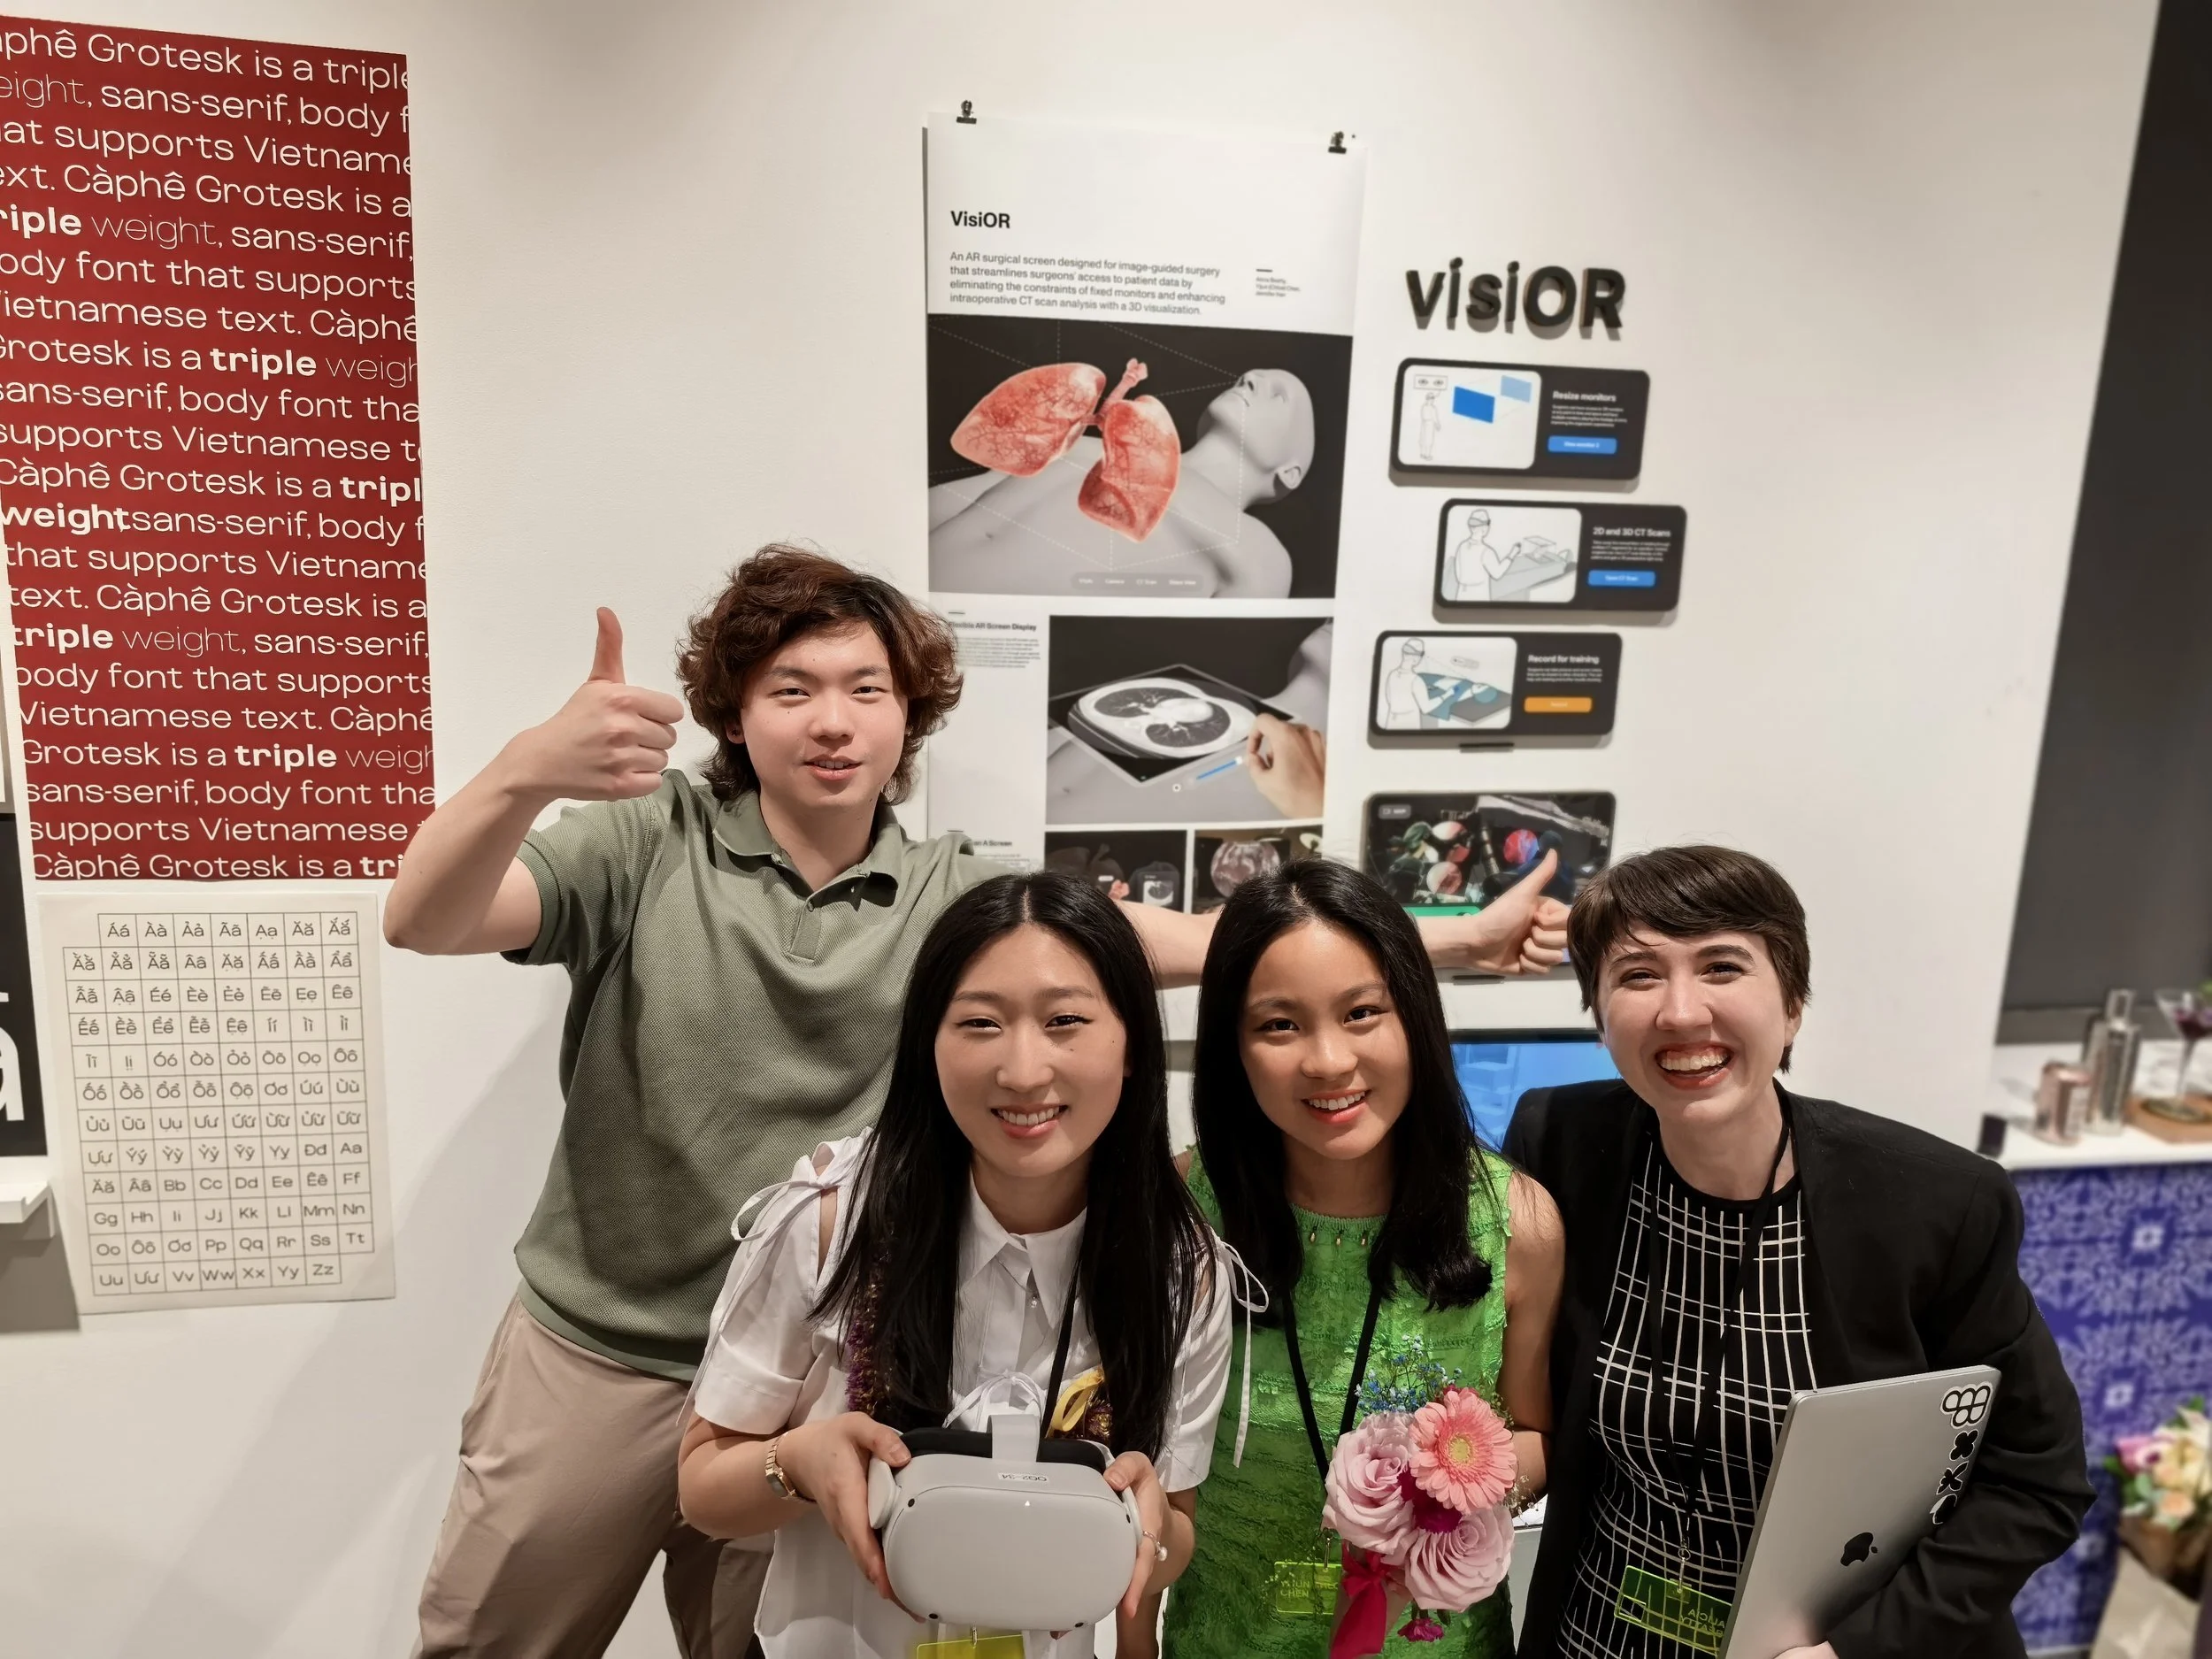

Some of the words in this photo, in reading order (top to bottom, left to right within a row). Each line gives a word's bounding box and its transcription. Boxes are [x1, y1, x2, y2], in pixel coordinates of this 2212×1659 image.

[0, 27, 77, 60] phê
[88, 34, 243, 74] Grotesk
[256, 50, 282, 78] is
[294, 60, 312, 81] a
[102, 86, 291, 125] sans-serif,
[300, 97, 389, 137] body
[0, 120, 43, 144] at
[55, 127, 234, 160] supports
[0, 165, 55, 190] xt.
[65, 164, 185, 202] Càphê
[196, 175, 344, 211] Grotesk
[356, 188, 381, 214] is
[393, 197, 411, 217] a
[951, 211, 1010, 228] VisiOR
[91, 215, 222, 250] weight,
[232, 227, 412, 261] sans-serif,
[76, 250, 156, 283] font
[166, 259, 245, 288] that
[950, 252, 964, 261] An
[966, 252, 979, 261] AR
[982, 255, 1020, 265] surgical
[1023, 257, 1056, 266] screen
[1057, 257, 1102, 270] designed
[1104, 260, 1117, 269] for
[1186, 267, 1220, 278] surgery
[950, 266, 969, 275] that
[972, 267, 1027, 278] streamlines
[1125, 275, 1157, 288] patient
[1159, 278, 1179, 287] data
[1181, 279, 1193, 289] by
[950, 280, 1003, 292] eliminating
[1006, 282, 1021, 291] the
[1024, 285, 1077, 294] constraints
[1079, 286, 1088, 295] of
[1090, 286, 1112, 296] fixed
[1114, 290, 1156, 299] monitors
[1157, 290, 1175, 300] and
[1177, 292, 1225, 304] enhancing
[950, 294, 1017, 304] intraoperative
[1019, 296, 1033, 305] CT
[1060, 300, 1097, 310] analysis
[1129, 302, 1142, 311] 3D
[1406, 257, 1626, 329] visiOR
[0, 290, 207, 328] ietnamese
[218, 307, 301, 334] text.
[311, 309, 415, 344] Càphê
[0, 334, 133, 365] rotesk
[143, 342, 171, 368] is
[181, 349, 201, 370] a
[210, 348, 316, 380] triple
[0, 382, 172, 412] ans-serif,
[180, 385, 268, 421] body
[279, 388, 352, 419] font
[172, 426, 390, 460] Vietnamese
[0, 457, 110, 495] Càphê
[120, 465, 265, 495] Grotesk
[277, 472, 302, 496] is
[312, 479, 331, 497] a
[319, 513, 405, 546] body
[8, 541, 78, 568] that
[88, 550, 257, 578] supports
[12, 587, 88, 609] text.
[97, 582, 211, 617] Càphê
[221, 588, 362, 616] Grotesk
[373, 594, 398, 618] is
[409, 600, 427, 618] a
[16, 623, 113, 654] triple
[122, 626, 246, 657] weight,
[255, 631, 429, 658] sans-serif,
[108, 663, 183, 688] font
[193, 666, 267, 690] that
[1527, 654, 1556, 663] Record
[1570, 656, 1600, 665] training
[22, 702, 232, 728] Vietnamese
[242, 708, 322, 730] text.
[331, 704, 433, 736] Càphê
[25, 739, 161, 765] Grotesk
[172, 742, 197, 765] is
[207, 749, 226, 766] a
[234, 743, 337, 772] triple
[28, 779, 198, 805] sans-serif,
[206, 780, 291, 810] body
[300, 780, 372, 804] font
[32, 820, 189, 846] supports
[199, 818, 408, 841] Vietnamese
[35, 852, 140, 879] Càphê
[150, 855, 288, 878] Grotesk
[299, 855, 324, 877] is
[334, 859, 351, 877] a
[164, 1179, 186, 1192] Bb
[200, 1178, 222, 1190] Cc
[235, 1177, 257, 1189] Dd
[273, 1176, 293, 1187] Ee
[343, 1171, 360, 1184] Ff
